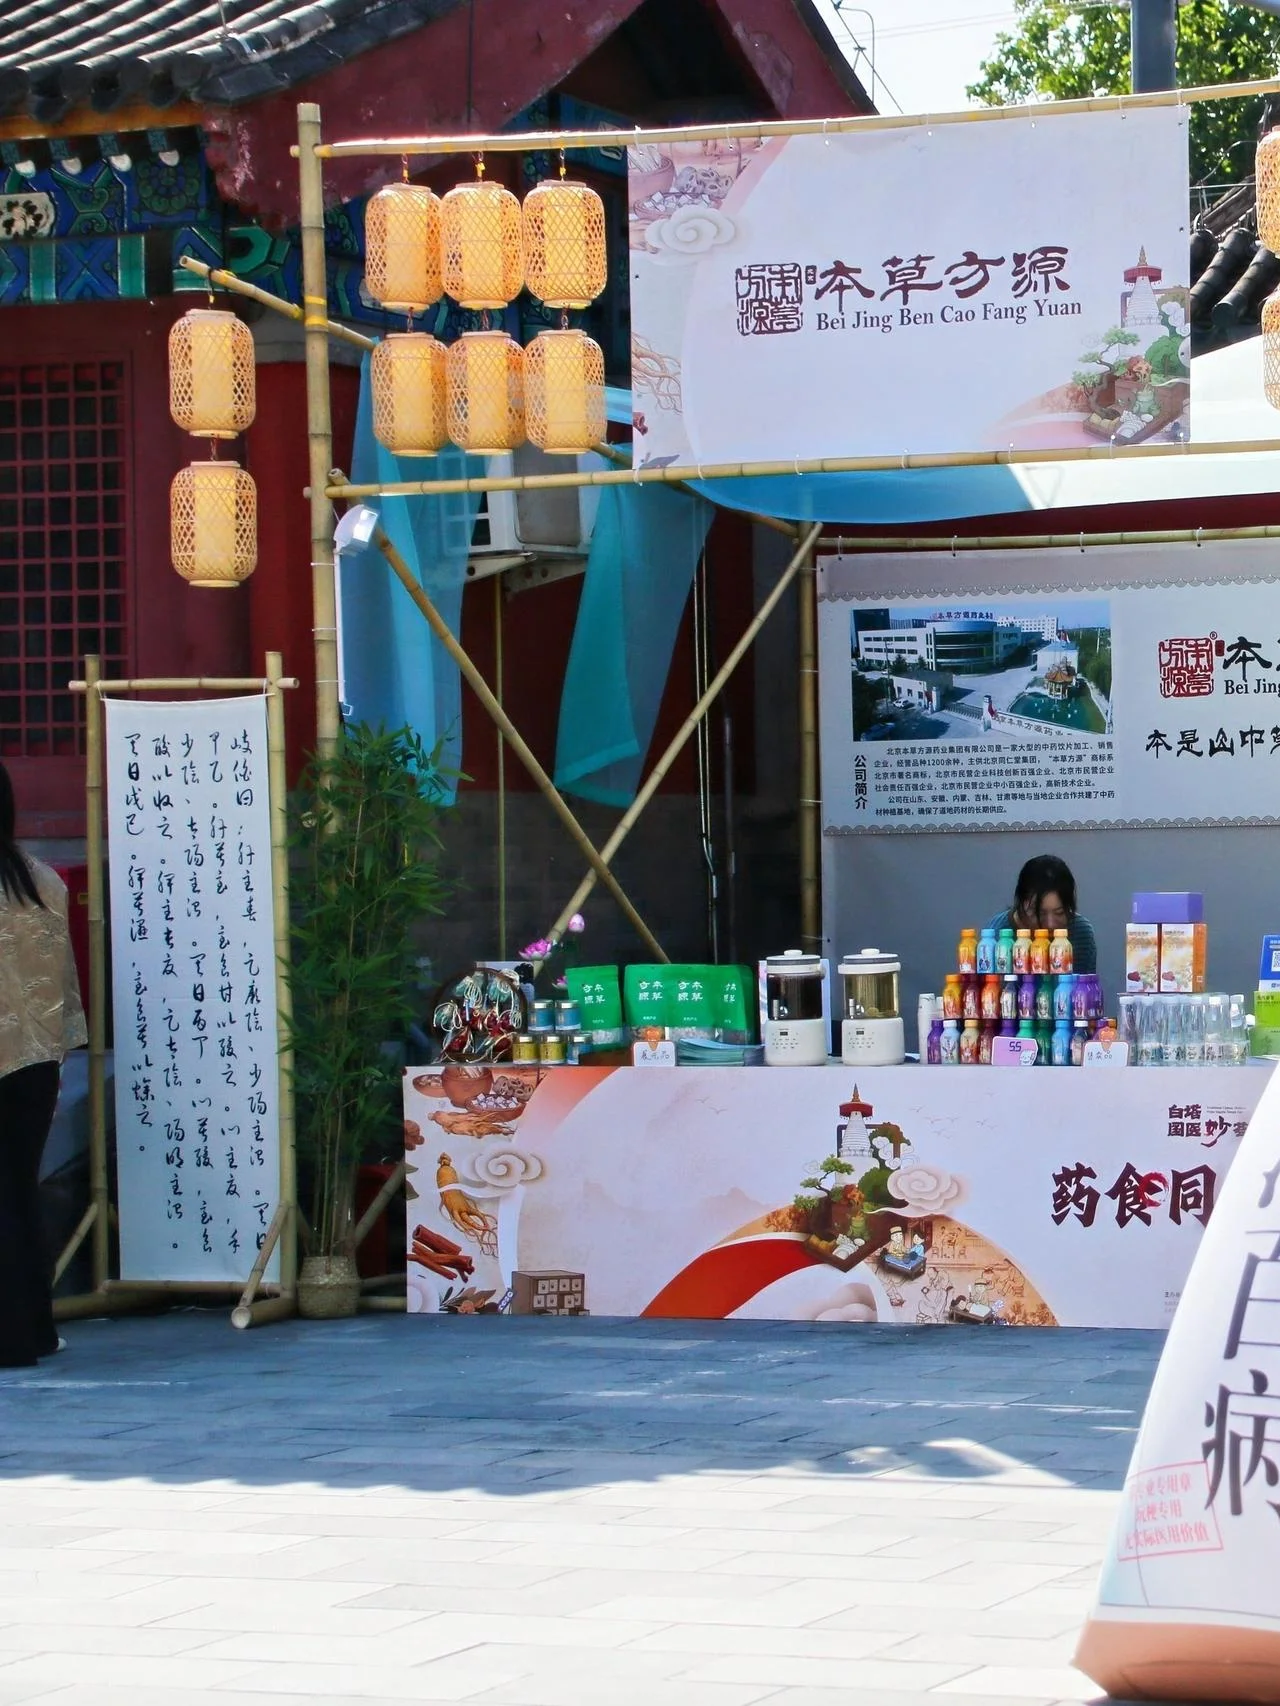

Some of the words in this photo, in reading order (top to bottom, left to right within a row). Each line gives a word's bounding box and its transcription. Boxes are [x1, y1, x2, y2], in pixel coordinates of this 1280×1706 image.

[814, 246, 1071, 312] 本草方源
[816, 312, 846, 331] Bei
[852, 310, 893, 334] Jing
[899, 307, 934, 327] Ben
[940, 305, 976, 324] Cao
[982, 302, 1028, 325] Fang
[1034, 298, 1083, 318] Yuan
[1224, 679, 1250, 696] Bei
[853, 754, 868, 810] 公司简介
[1168, 1103, 1202, 1120] 白塔
[1051, 1161, 1218, 1229] 药食同
